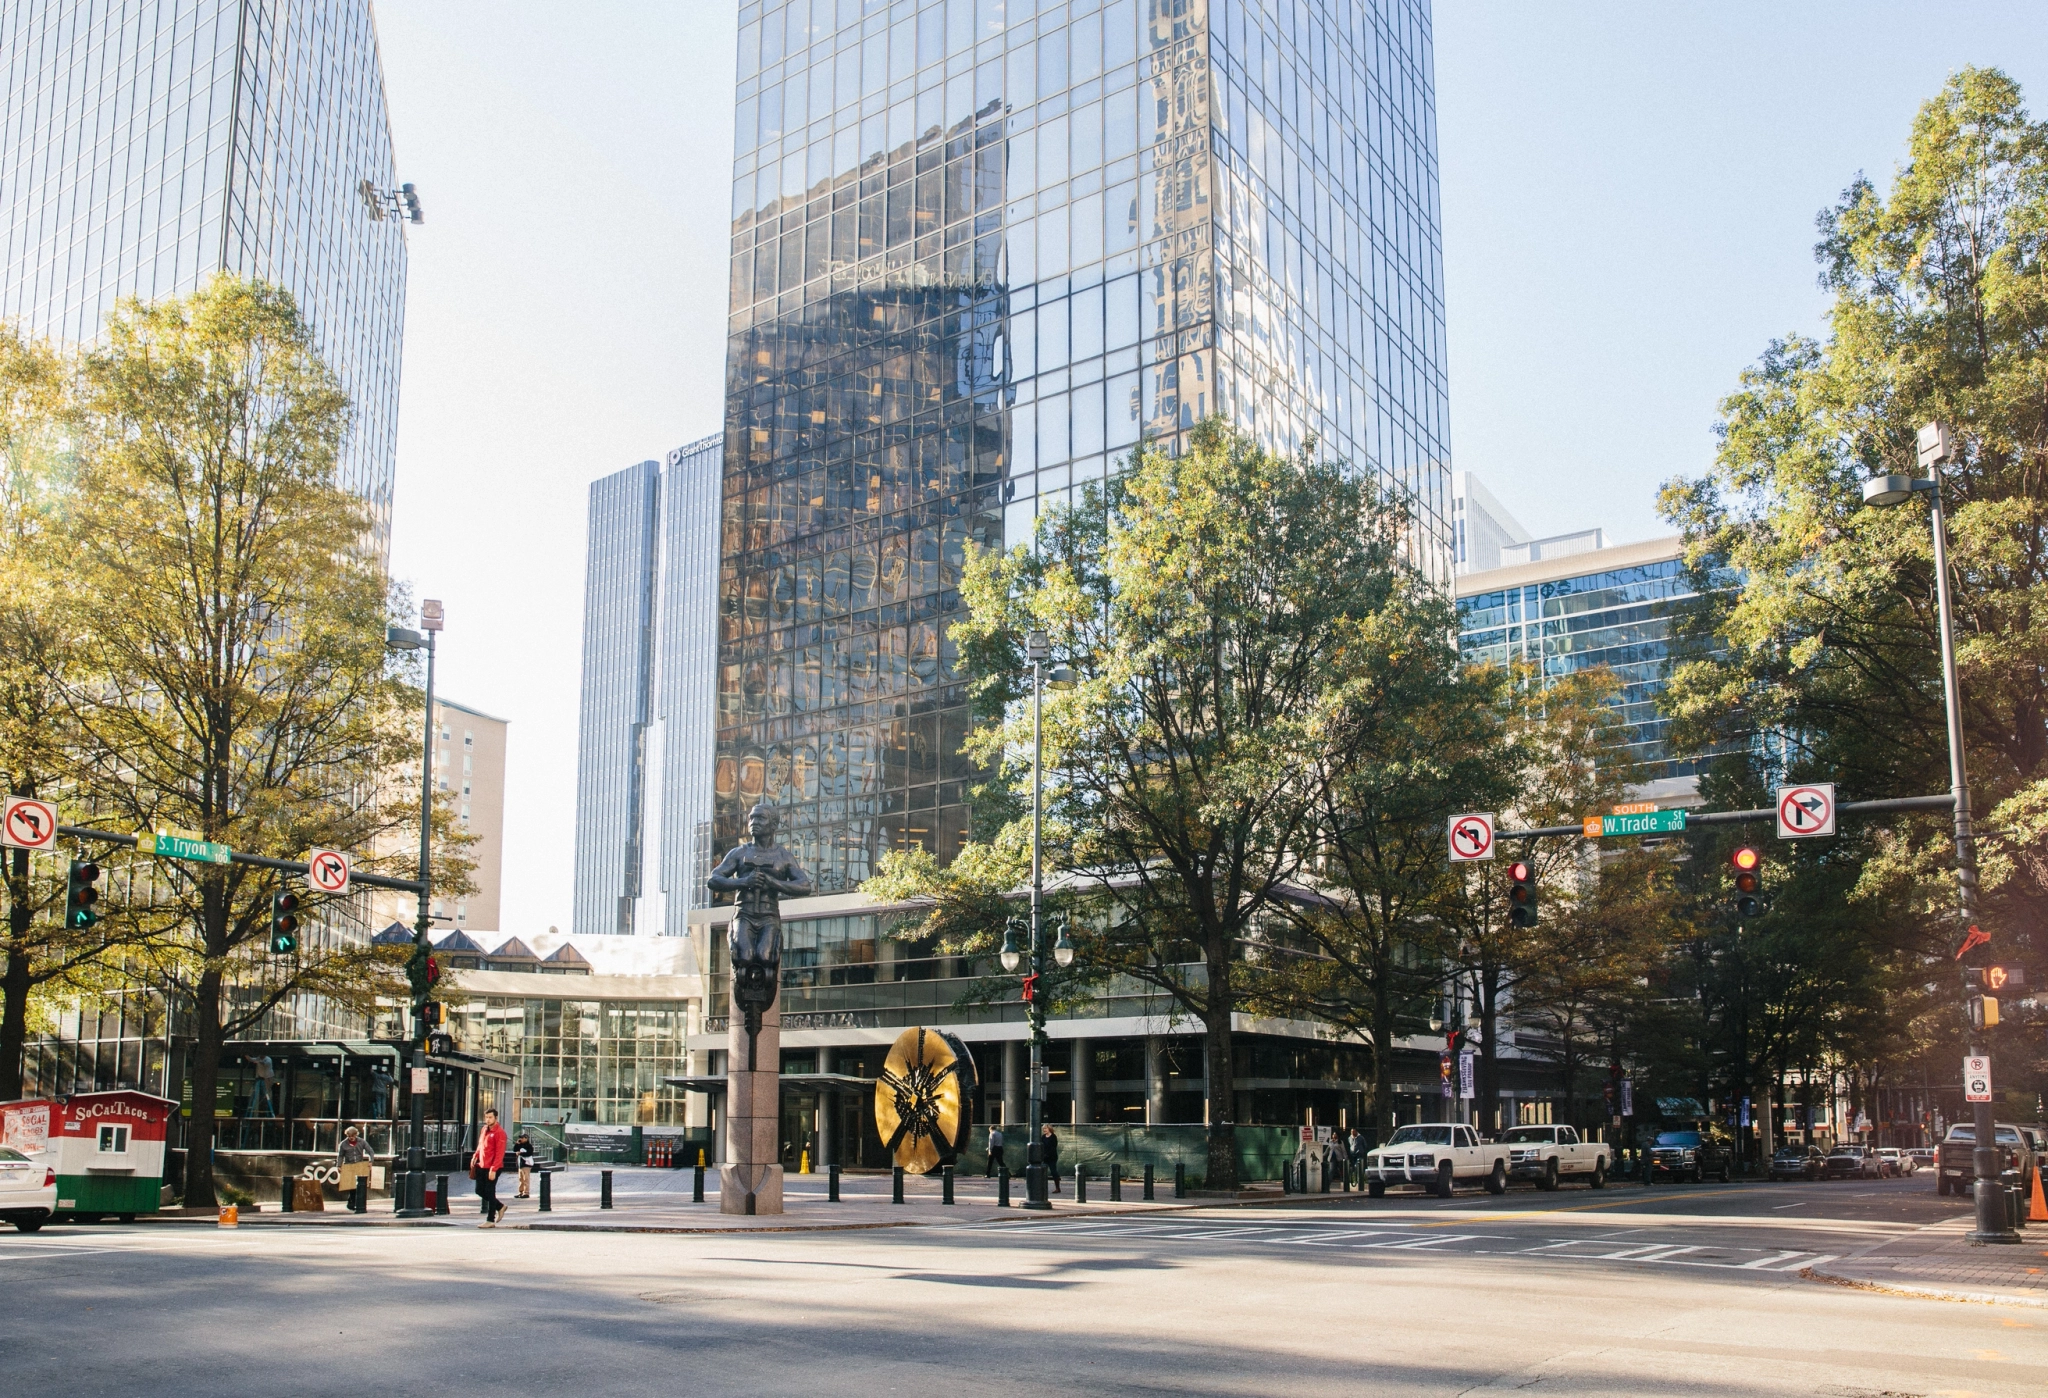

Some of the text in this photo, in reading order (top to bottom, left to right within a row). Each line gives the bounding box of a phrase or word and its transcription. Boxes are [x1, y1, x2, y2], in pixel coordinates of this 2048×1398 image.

[1615, 803, 1653, 815] SOUTH
[1604, 810, 1682, 832] W. Trade St
[1667, 821, 1683, 831] 100
[171, 828, 197, 840] EAST
[158, 836, 229, 857] S. Tryon St
[215, 853, 228, 863] 100
